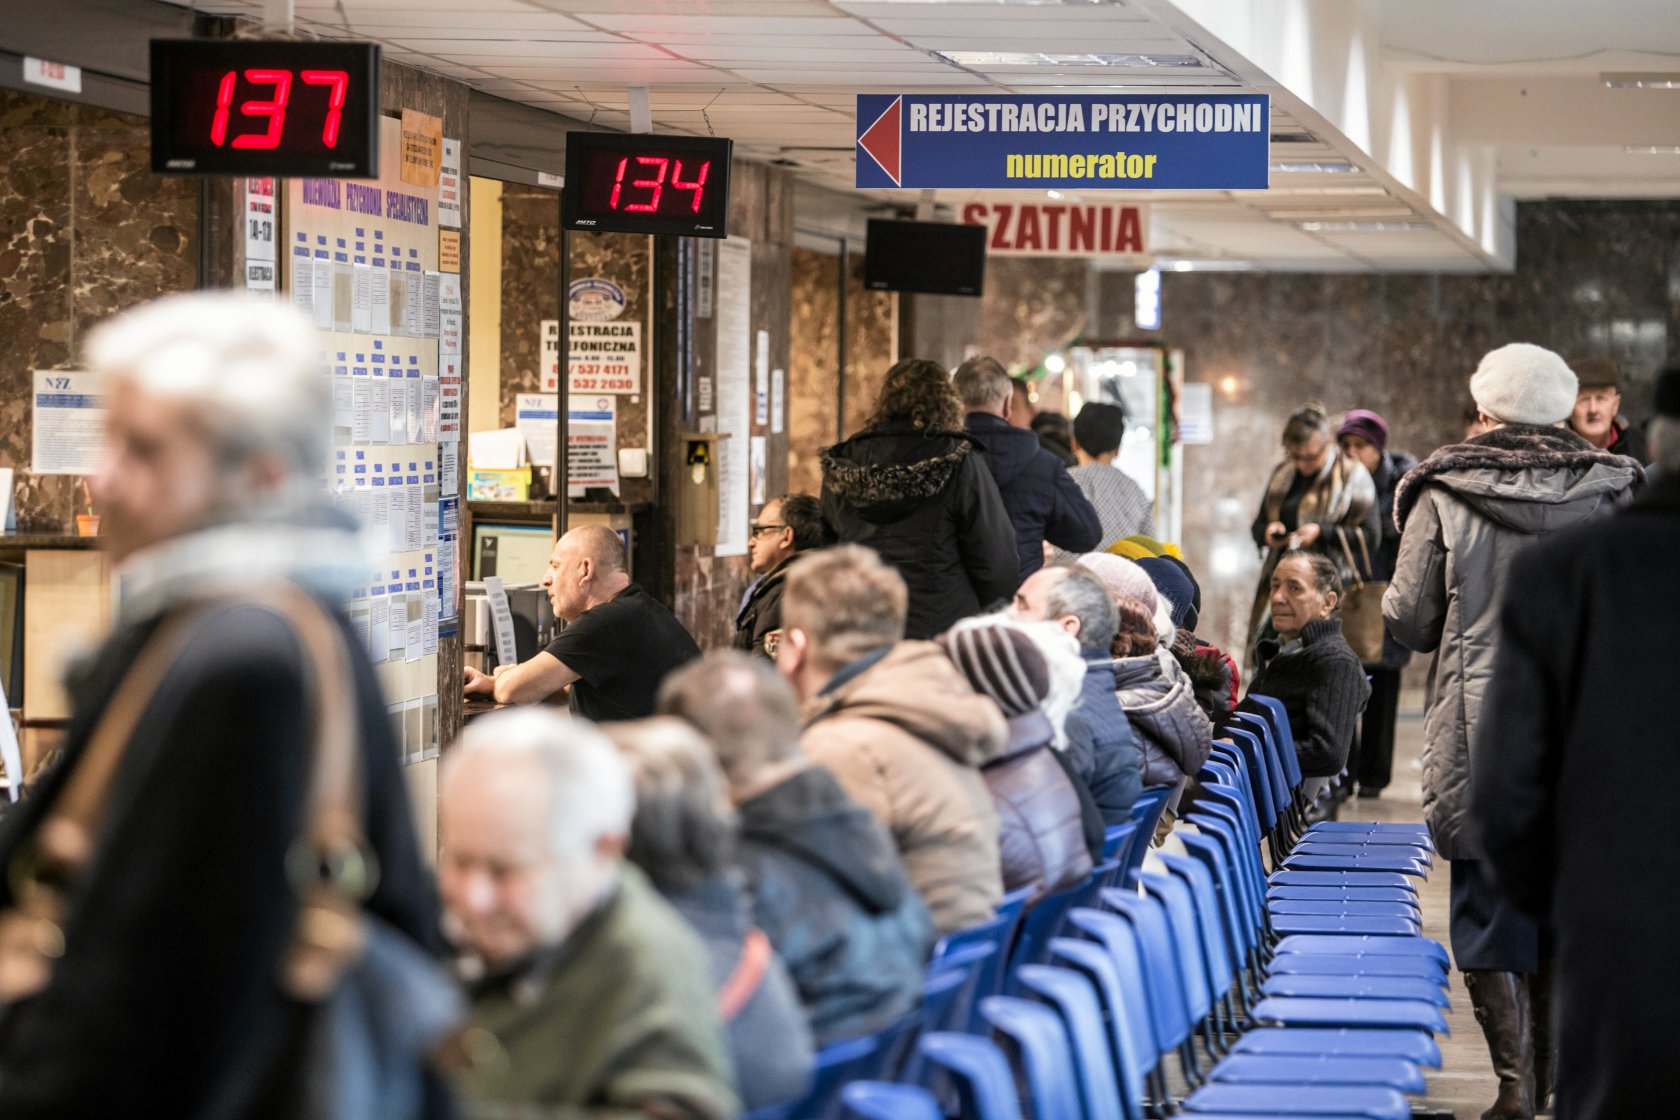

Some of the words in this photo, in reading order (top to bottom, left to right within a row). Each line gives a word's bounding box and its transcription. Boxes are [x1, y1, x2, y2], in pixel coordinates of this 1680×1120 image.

[210, 69, 349, 150] 137
[909, 103, 1085, 133] REJESTRACJA
[1091, 103, 1261, 133] PRZYCHODNI
[1006, 152, 1157, 178] numerator
[609, 157, 711, 214] 134
[549, 325, 634, 336] RESTRACJA
[546, 341, 636, 352] TEEFONICZNA
[578, 364, 600, 374] 537
[603, 365, 629, 375] 4171
[573, 379, 597, 388] 532
